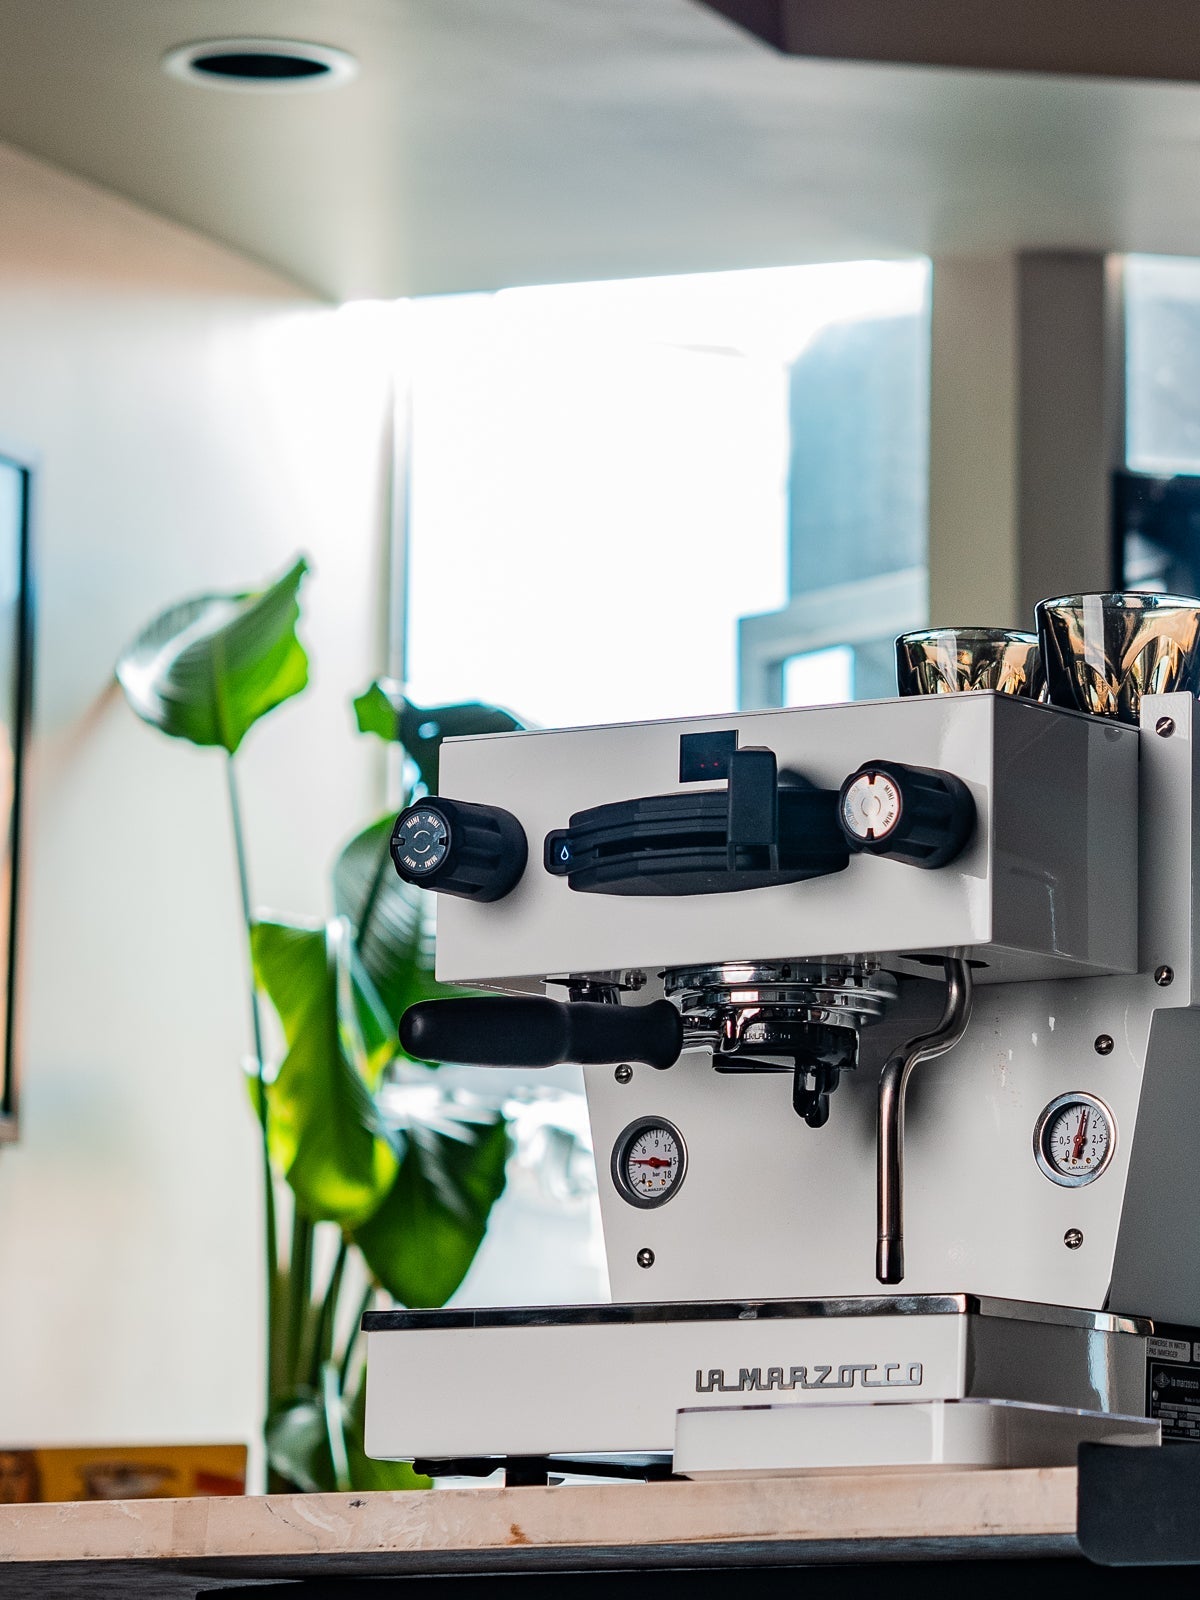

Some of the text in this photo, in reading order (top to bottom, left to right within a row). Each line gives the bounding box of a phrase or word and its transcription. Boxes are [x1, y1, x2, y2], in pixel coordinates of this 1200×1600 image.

[406, 815, 440, 829] MINI MINI
[1059, 1136, 1071, 1146] 0,5
[1091, 1134, 1104, 1144] 2,5
[663, 1143, 672, 1153] 12
[663, 1170, 672, 1179] 18
